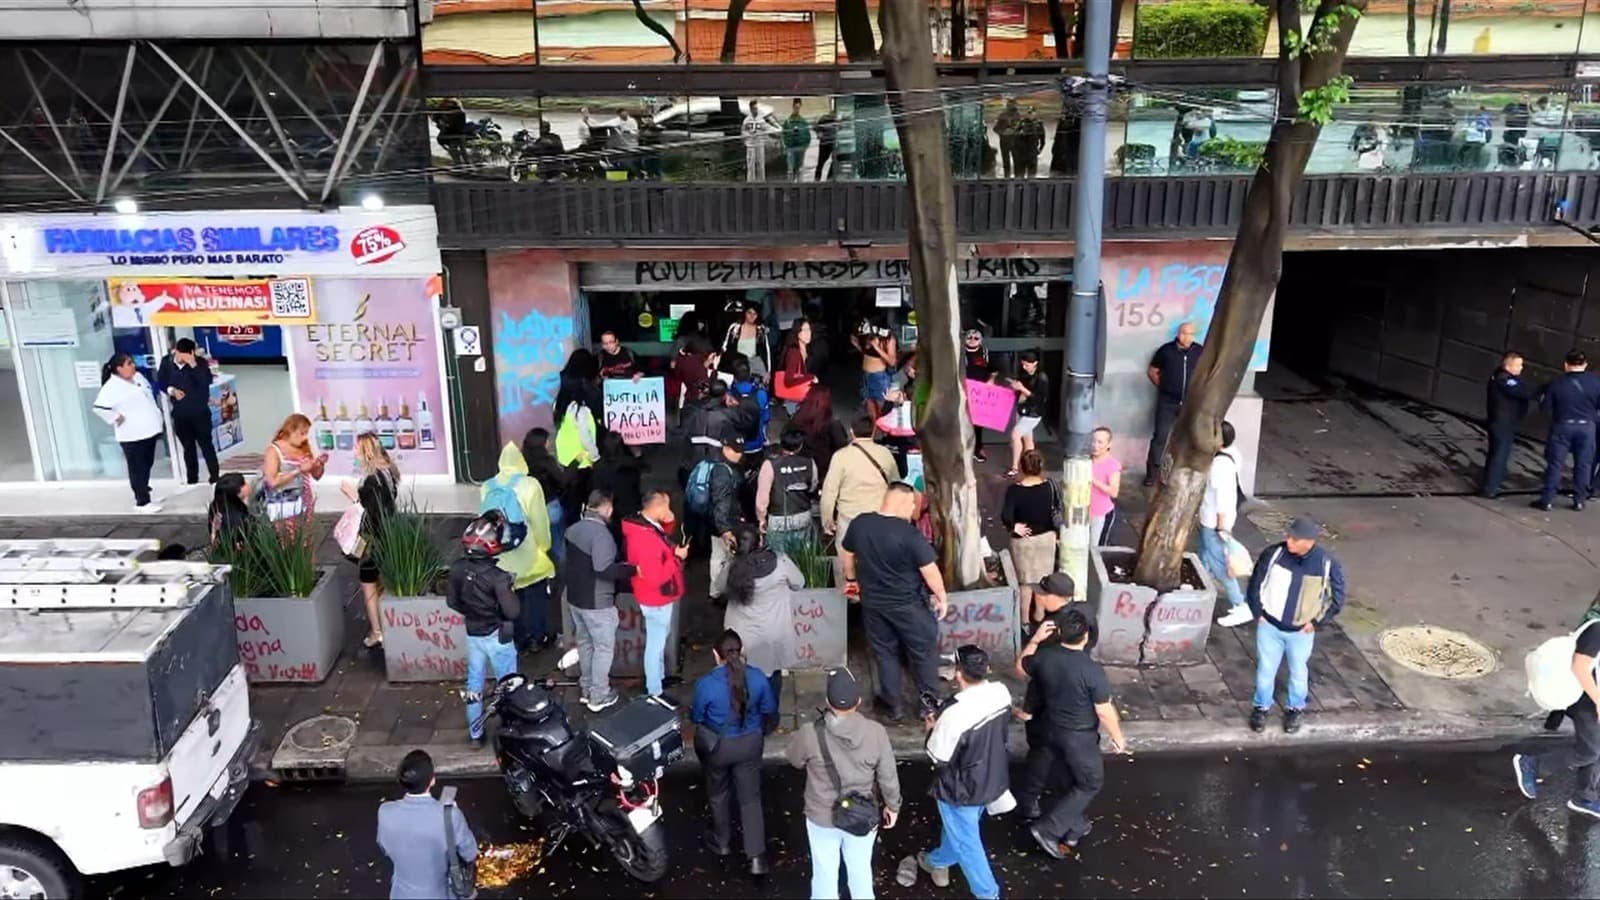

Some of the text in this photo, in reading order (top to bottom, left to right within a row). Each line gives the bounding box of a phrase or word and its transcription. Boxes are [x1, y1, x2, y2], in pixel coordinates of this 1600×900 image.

[44, 227, 196, 253] FARMACIAS
[201, 226, 340, 253] SIMILARES
[356, 231, 392, 257] 75%
[130, 255, 169, 265] MISMO
[172, 255, 204, 265] PERO
[207, 255, 233, 264] MAS
[635, 261, 696, 284] AQUI
[770, 261, 798, 281] LA
[1115, 263, 1225, 300] LA FISC
[205, 285, 262, 296] TENEMOS
[180, 296, 267, 310] INSULINAS!
[1115, 303, 1165, 327] 156
[306, 323, 425, 342] ETERNAL
[315, 342, 416, 362] SECRET
[606, 390, 659, 406] JUSTICIA
[607, 410, 660, 431] PAOLA
